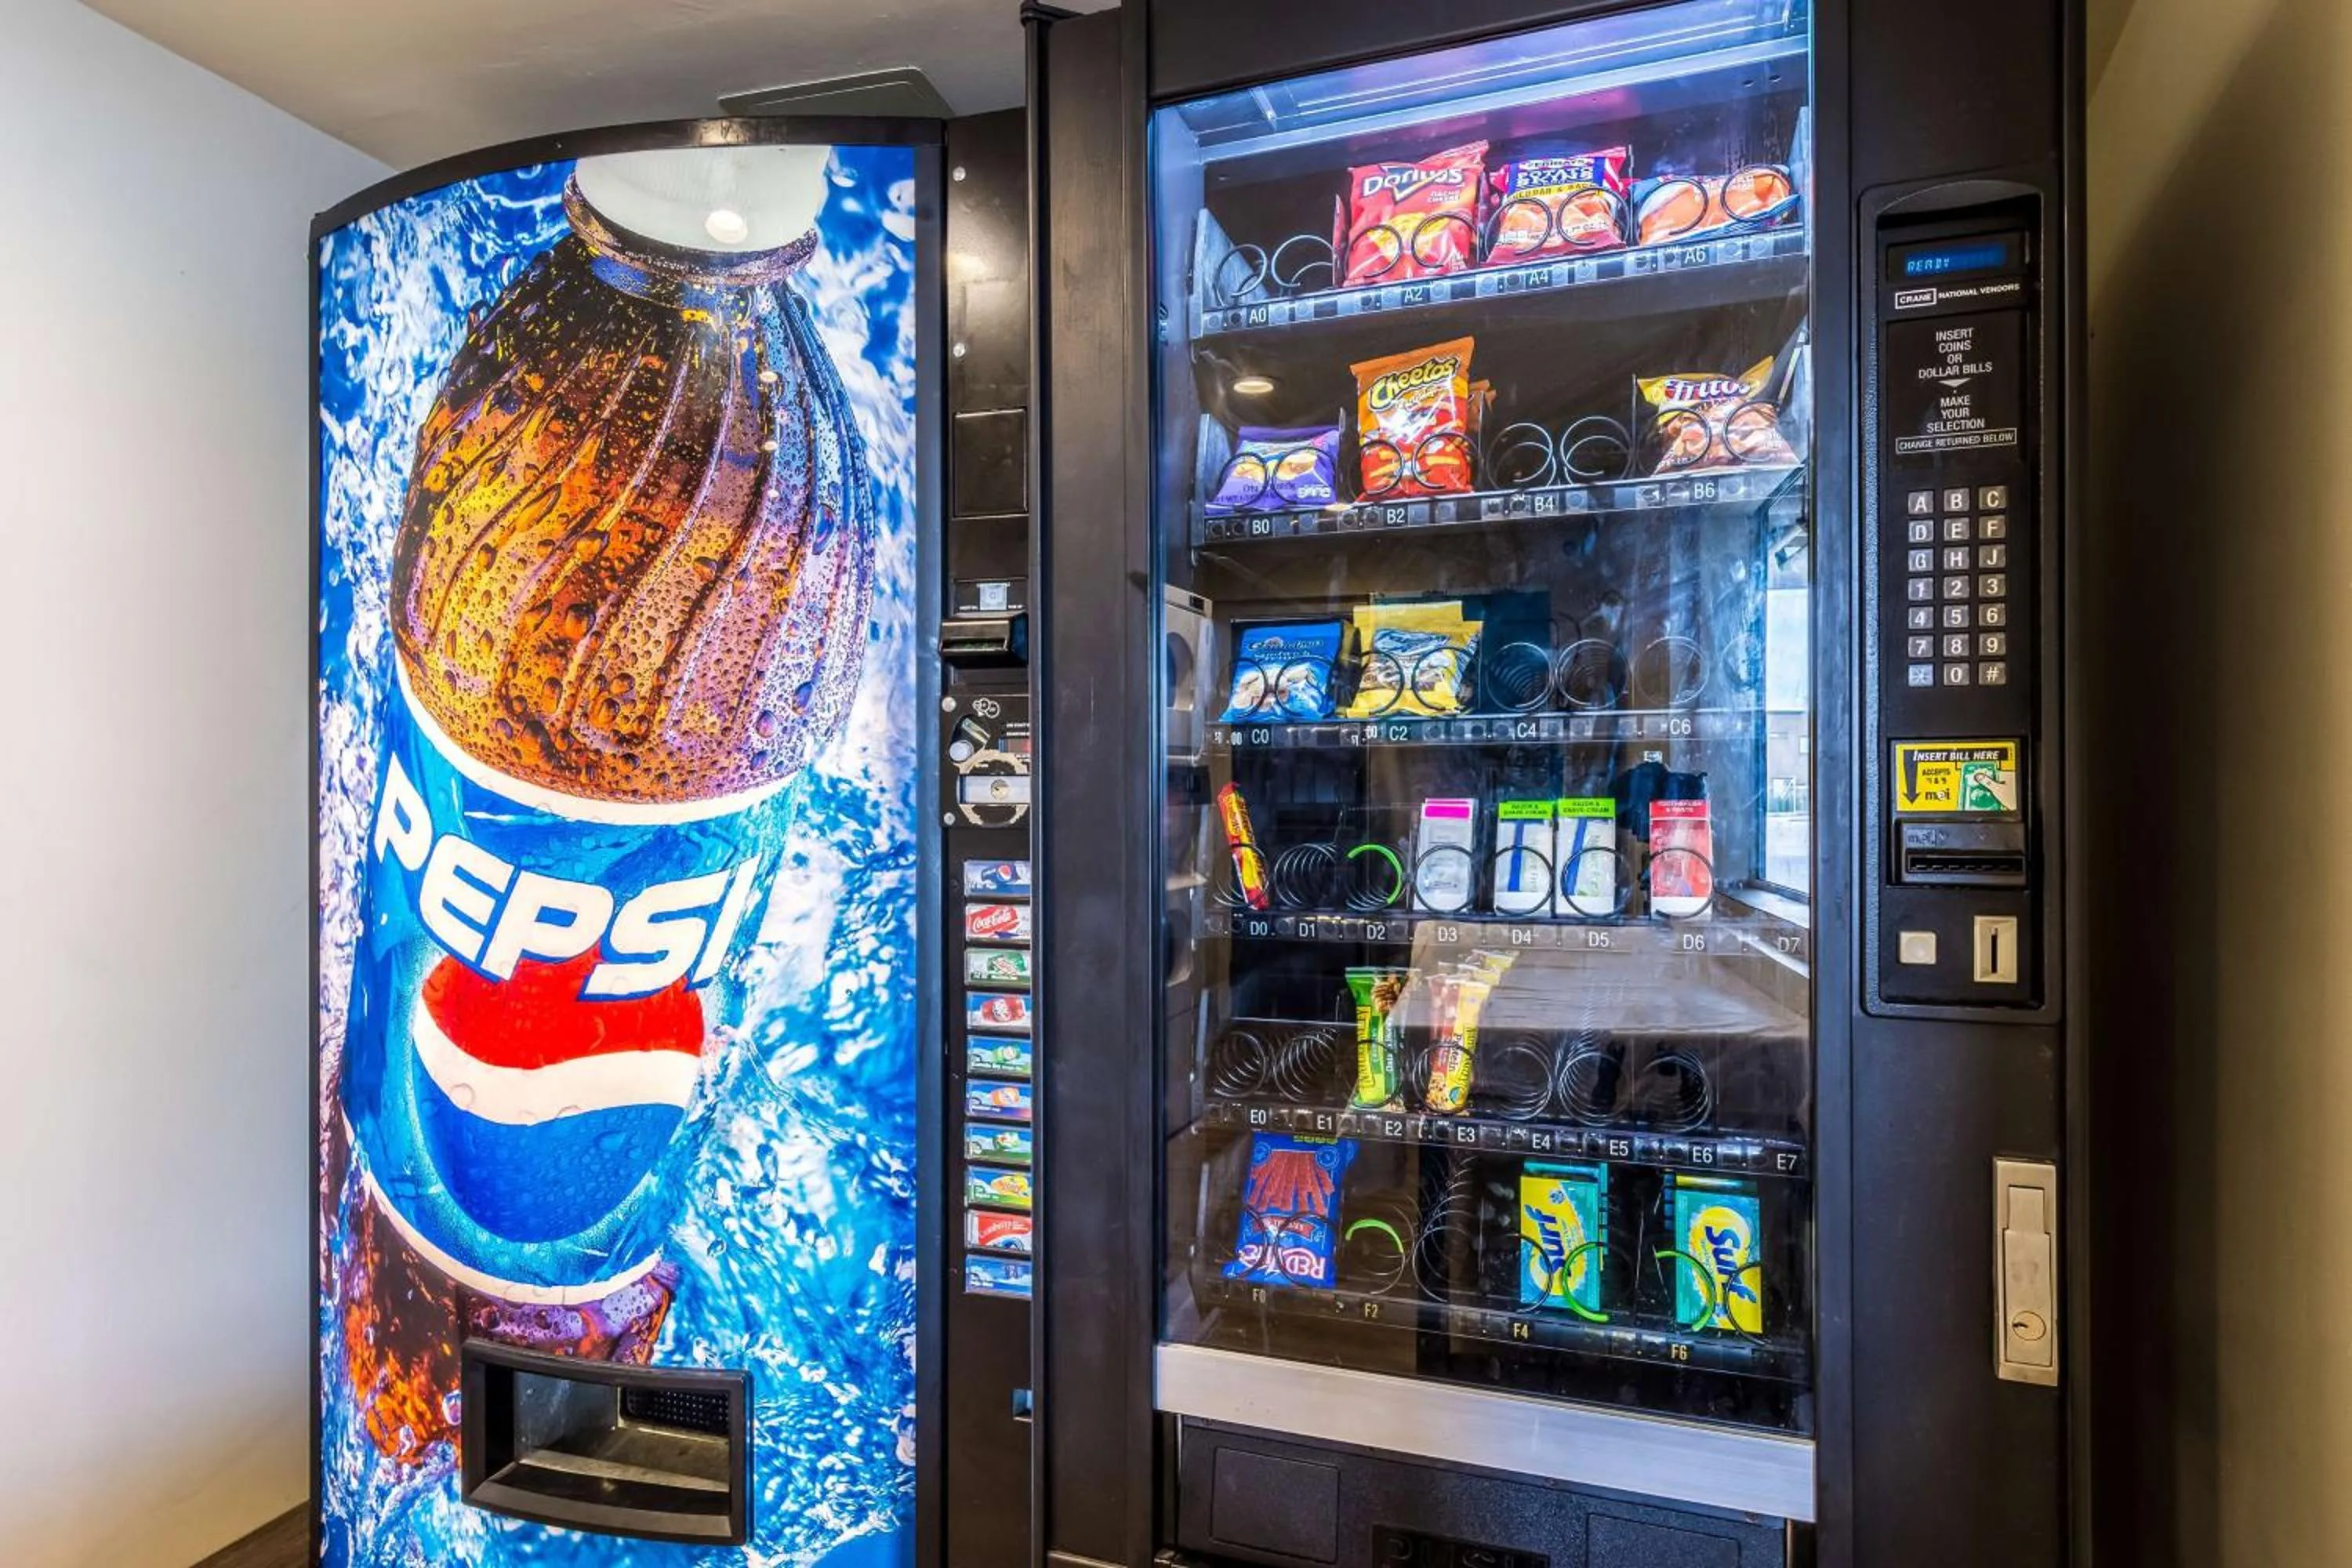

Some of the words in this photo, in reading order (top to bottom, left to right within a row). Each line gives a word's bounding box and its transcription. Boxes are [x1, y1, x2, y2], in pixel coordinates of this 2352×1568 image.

[1363, 168, 1464, 197] Doritos
[1685, 249, 1705, 263] A6
[1907, 257, 1950, 272] READY
[1530, 270, 1548, 285] A4
[1404, 288, 1423, 302] A2
[1900, 293, 1932, 304] CRANE
[1938, 288, 1978, 299] NATIONAL
[1980, 283, 2020, 294] VENDORS
[1249, 308, 1266, 324] A0
[1936, 328, 1973, 341] INSERT
[1939, 340, 1971, 353] COINS
[1947, 354, 1962, 365] OR
[1918, 365, 1959, 379] DOLLAR
[1963, 362, 1992, 375] BILLS
[1370, 356, 1459, 412] Cheetos
[1940, 395, 1970, 407] MAKE
[1941, 408, 1969, 419] YOUR
[1927, 419, 1985, 433] SELECTION
[1899, 438, 1933, 450] CHANGE
[1935, 435, 1980, 448] RETURNED
[1983, 433, 2014, 444] BELOW
[1694, 483, 1715, 499] B6
[1534, 496, 1555, 511] B4
[1915, 496, 1927, 512] A
[1951, 493, 1962, 509] B
[1987, 490, 1998, 507] C
[1387, 509, 1405, 524] B2
[1252, 520, 1269, 534] B0
[1915, 526, 1927, 541] D
[1951, 523, 1962, 539] E
[1987, 520, 1998, 536] F
[1915, 554, 1926, 569] G
[1951, 552, 1962, 567] H
[1987, 550, 1997, 565] J
[1918, 583, 1924, 597] 1
[1951, 580, 1962, 595] 2
[1987, 578, 1998, 594] 3
[1915, 612, 1925, 626] 4
[1951, 610, 1962, 624] 5
[1987, 608, 1998, 623] 6
[1915, 640, 1926, 655] 7
[1951, 639, 1962, 653] 8
[1987, 637, 1998, 653] 9
[1951, 667, 1962, 682] 0
[1389, 726, 1408, 741] C2
[1517, 722, 1537, 738] C4
[1670, 719, 1691, 735] C6
[1251, 728, 1269, 744] C0
[1913, 750, 1949, 761] INSERT
[1950, 750, 1970, 760] BILL
[1973, 750, 2000, 760] HERE
[373, 752, 762, 996] PEPSI
[1250, 921, 1268, 935] D0
[1299, 923, 1316, 938] D1
[1367, 924, 1386, 940] D2
[1438, 927, 1457, 942] D3
[1512, 930, 1532, 944] D4
[1588, 931, 1609, 947] D5
[1683, 934, 1705, 950] D6
[1777, 937, 1801, 953] D7
[1250, 1109, 1266, 1125] E0
[1316, 1114, 1333, 1130] E1
[1385, 1120, 1402, 1136] E2
[1457, 1127, 1475, 1142] E3
[1532, 1134, 1551, 1150] E4
[1609, 1139, 1629, 1156] E5
[1692, 1145, 1713, 1163] E6
[1777, 1152, 1797, 1171] E7
[1279, 1247, 1326, 1279] RED
[1704, 1225, 1757, 1304] Surf
[1252, 1289, 1266, 1304] F0
[1364, 1304, 1379, 1319] F2
[1513, 1323, 1528, 1339] F4
[1671, 1346, 1688, 1361] F6
